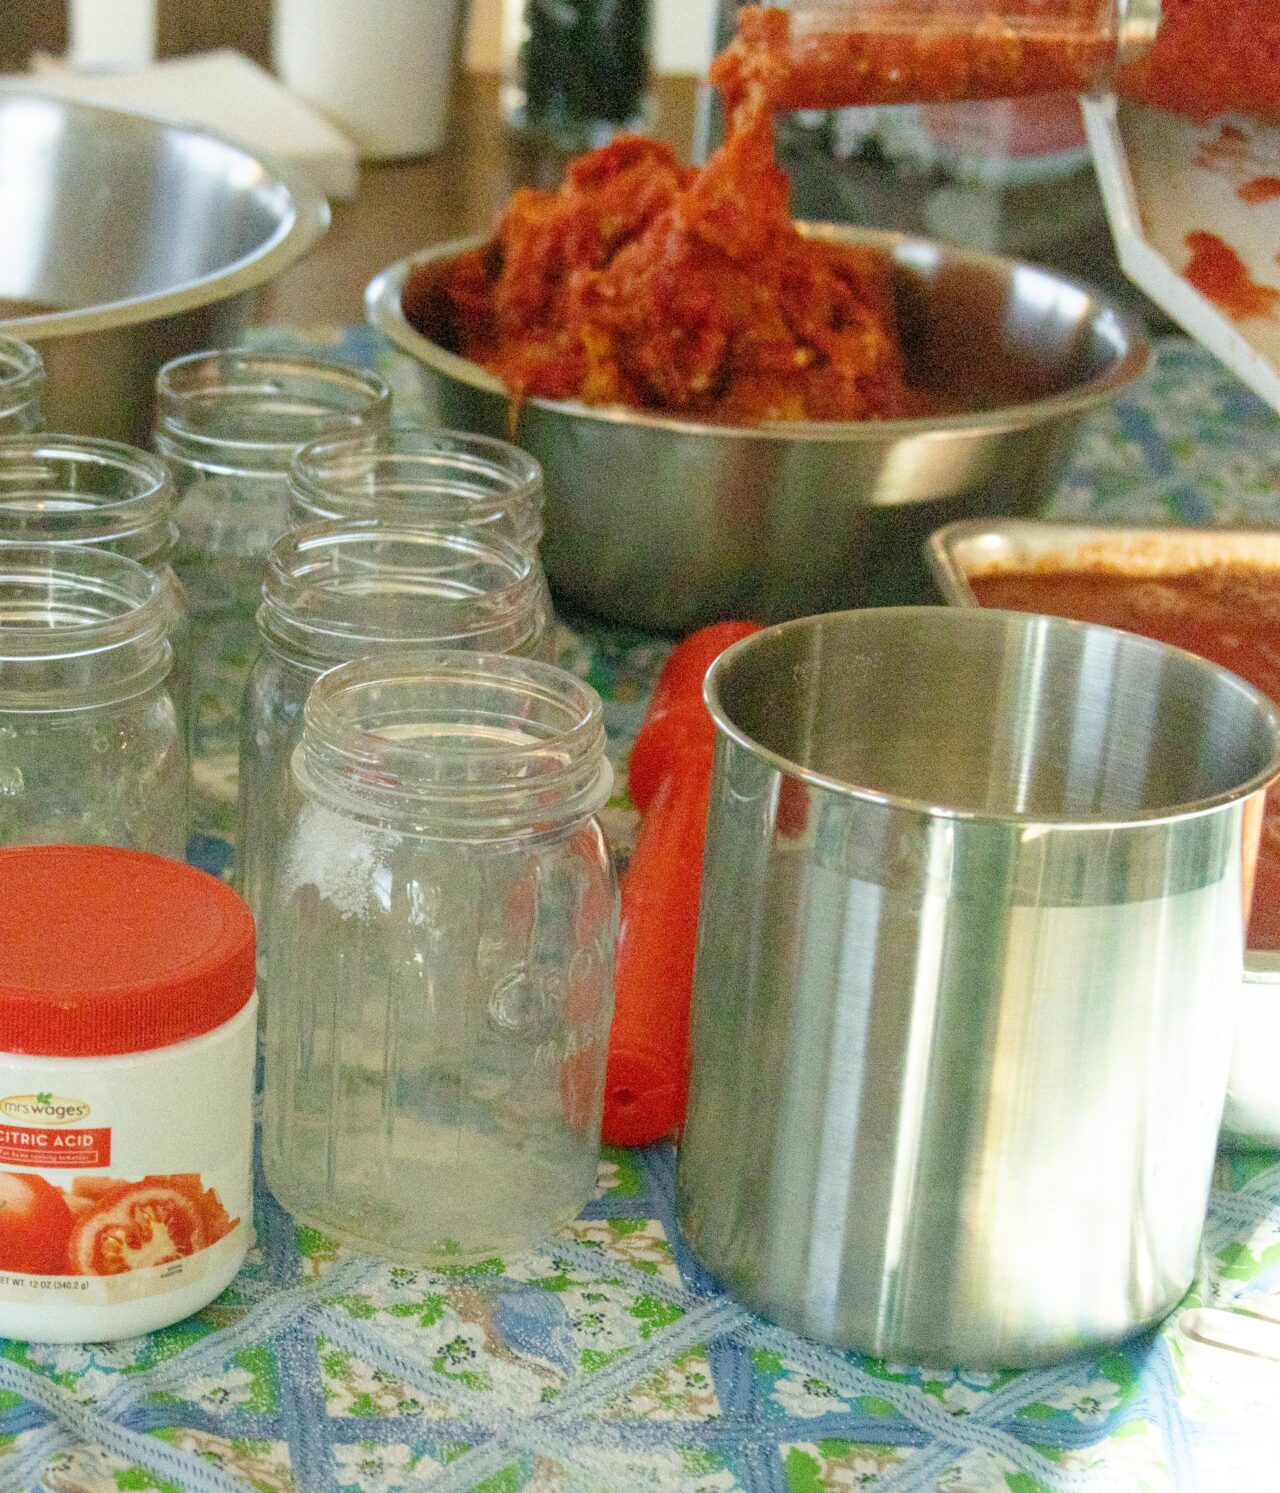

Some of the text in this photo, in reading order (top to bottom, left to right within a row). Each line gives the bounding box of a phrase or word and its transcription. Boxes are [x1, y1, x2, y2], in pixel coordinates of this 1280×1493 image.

[53, 1134, 94, 1147] ACID
[29, 1279, 38, 1288] 12
[40, 1281, 51, 1289] OZ
[54, 1280, 79, 1290] (340.2
[81, 1281, 89, 1291] g)
